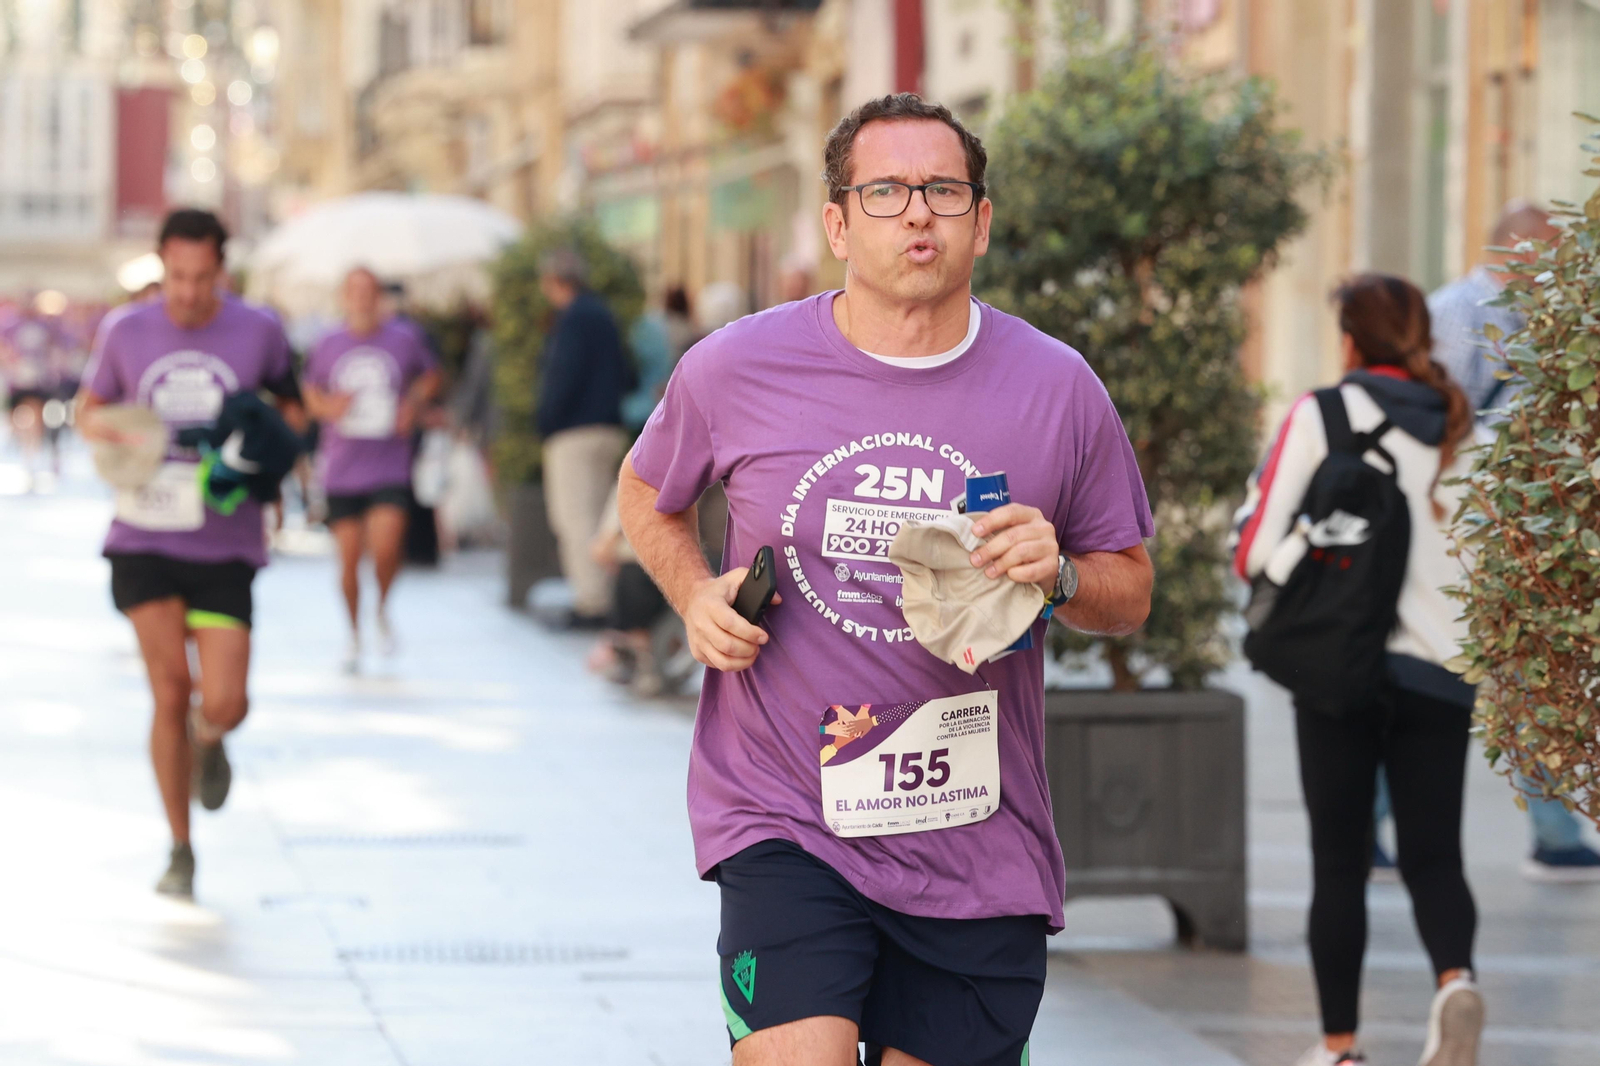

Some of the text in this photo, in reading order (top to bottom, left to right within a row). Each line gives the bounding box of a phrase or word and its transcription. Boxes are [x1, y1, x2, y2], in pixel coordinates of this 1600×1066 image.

[780, 503, 800, 537] DÍA
[792, 432, 935, 501] INTERNACIONAL
[854, 464, 944, 503] 25N
[832, 504, 949, 521] SERVICIO DE EMERGENC
[845, 517, 867, 533] 24
[829, 535, 871, 554] 900
[783, 545, 840, 625] MUJERES
[853, 570, 904, 584] Ayuntamiento
[837, 589, 860, 599] fmm
[861, 591, 883, 602] CÁDIZ
[841, 619, 878, 641] LAS
[941, 705, 990, 721] CARRERA
[958, 715, 991, 725] ELIMINACIÓN
[936, 732, 957, 741] CONTRA
[968, 727, 991, 735] MUJERES
[963, 721, 991, 730] VIOLENCIA
[878, 748, 951, 792] 155
[836, 785, 989, 812] EL AMOR NO LASTIMA
